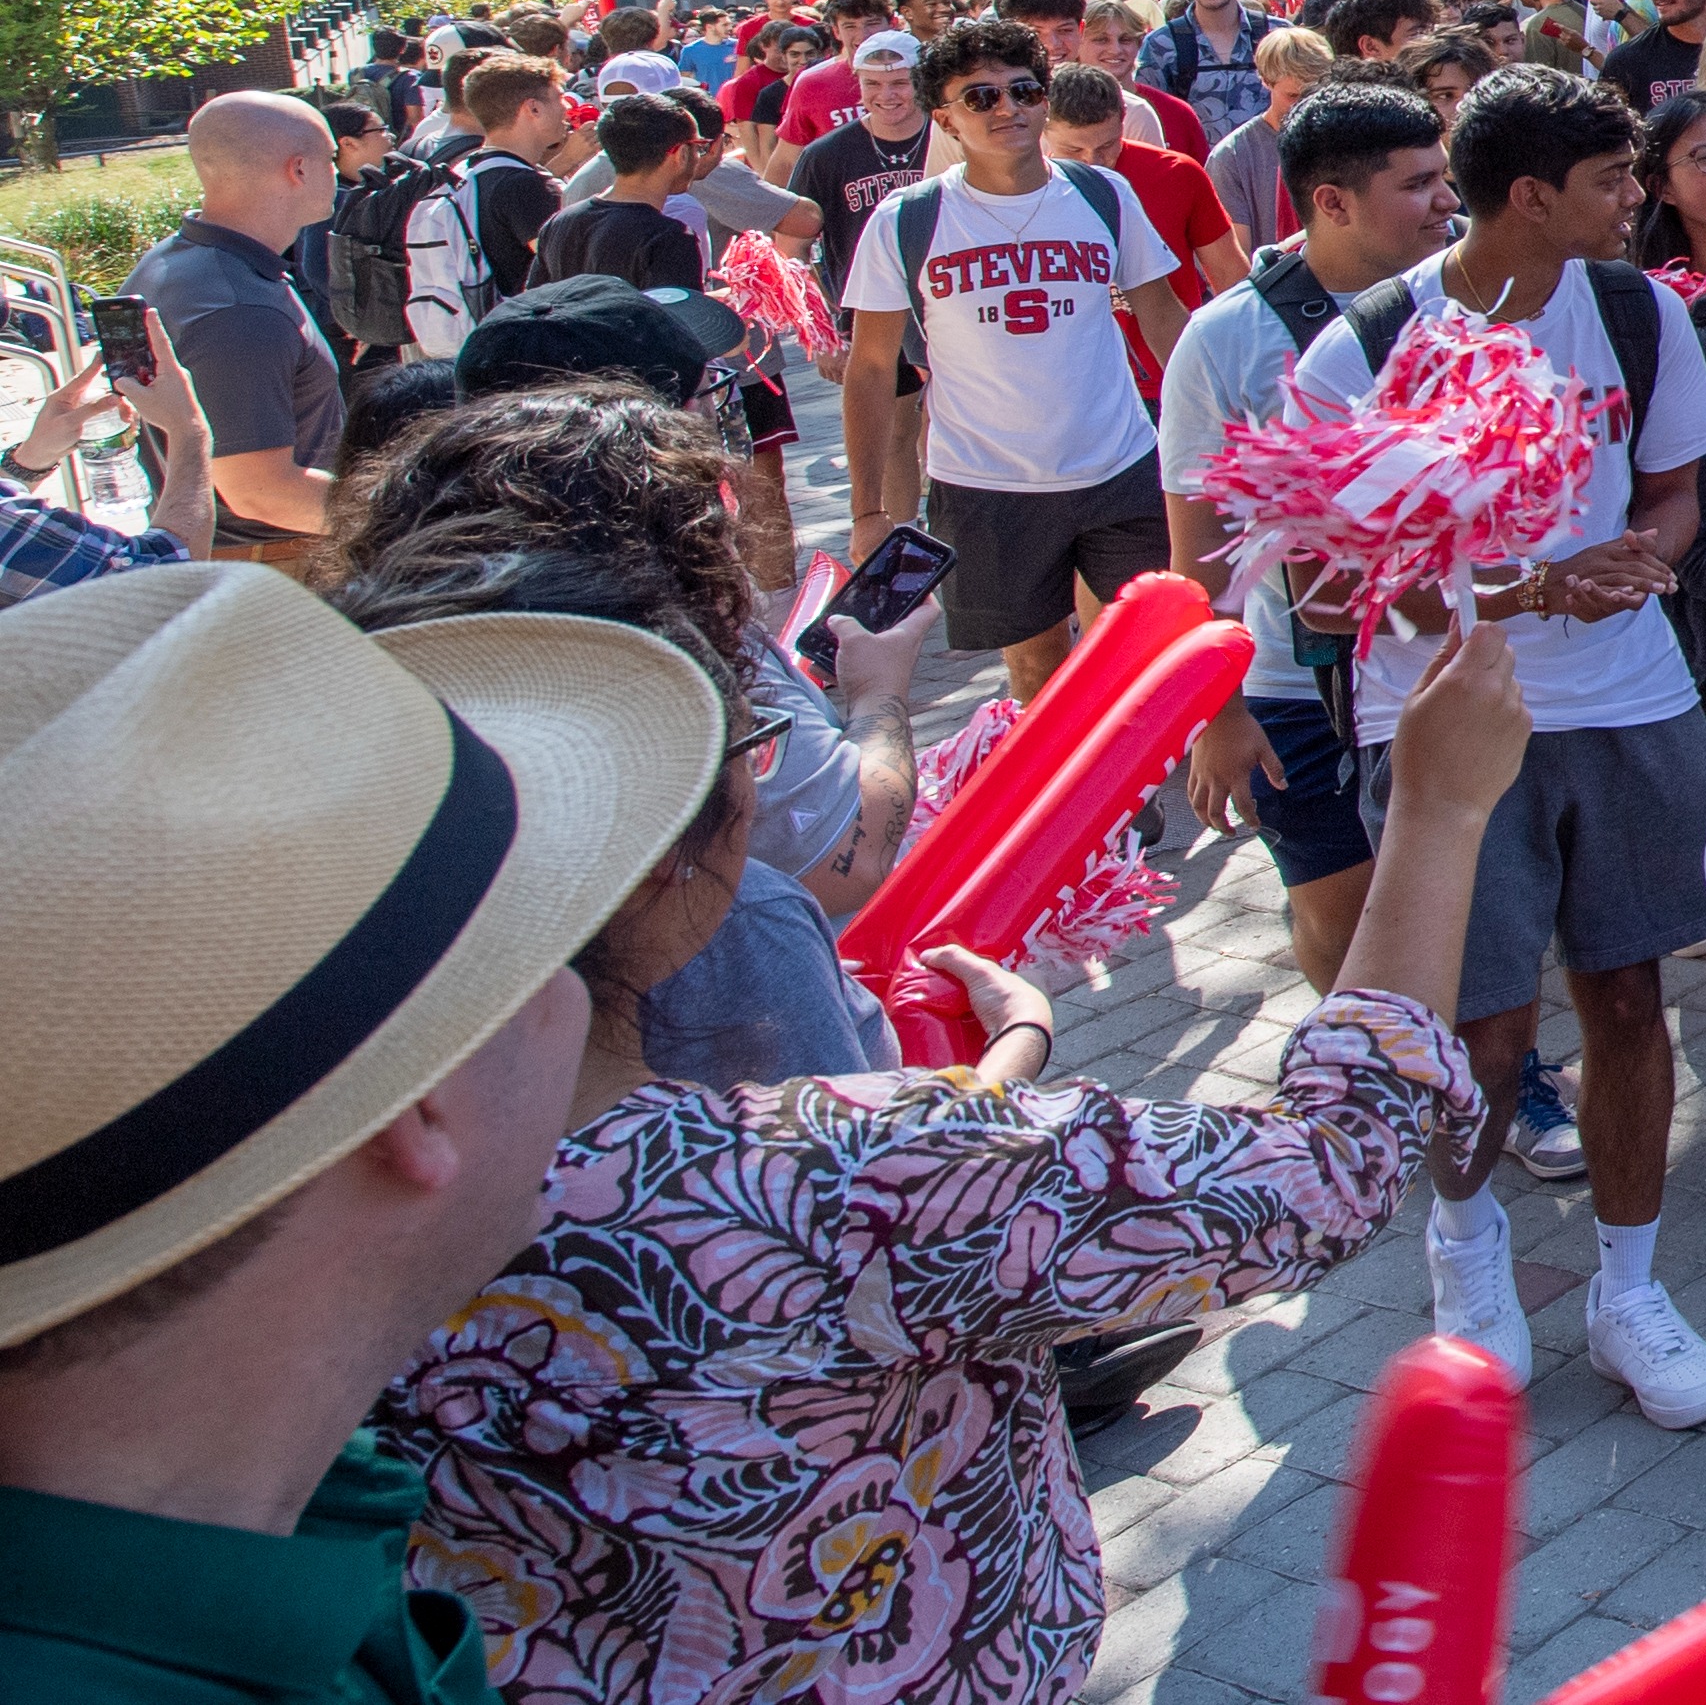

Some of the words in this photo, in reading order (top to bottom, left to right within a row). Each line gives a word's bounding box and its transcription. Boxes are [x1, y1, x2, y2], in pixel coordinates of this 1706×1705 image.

[927, 240, 1111, 300] STEVENS
[977, 306, 999, 323] 18
[1004, 288, 1051, 336] S
[1051, 298, 1075, 317] 70
